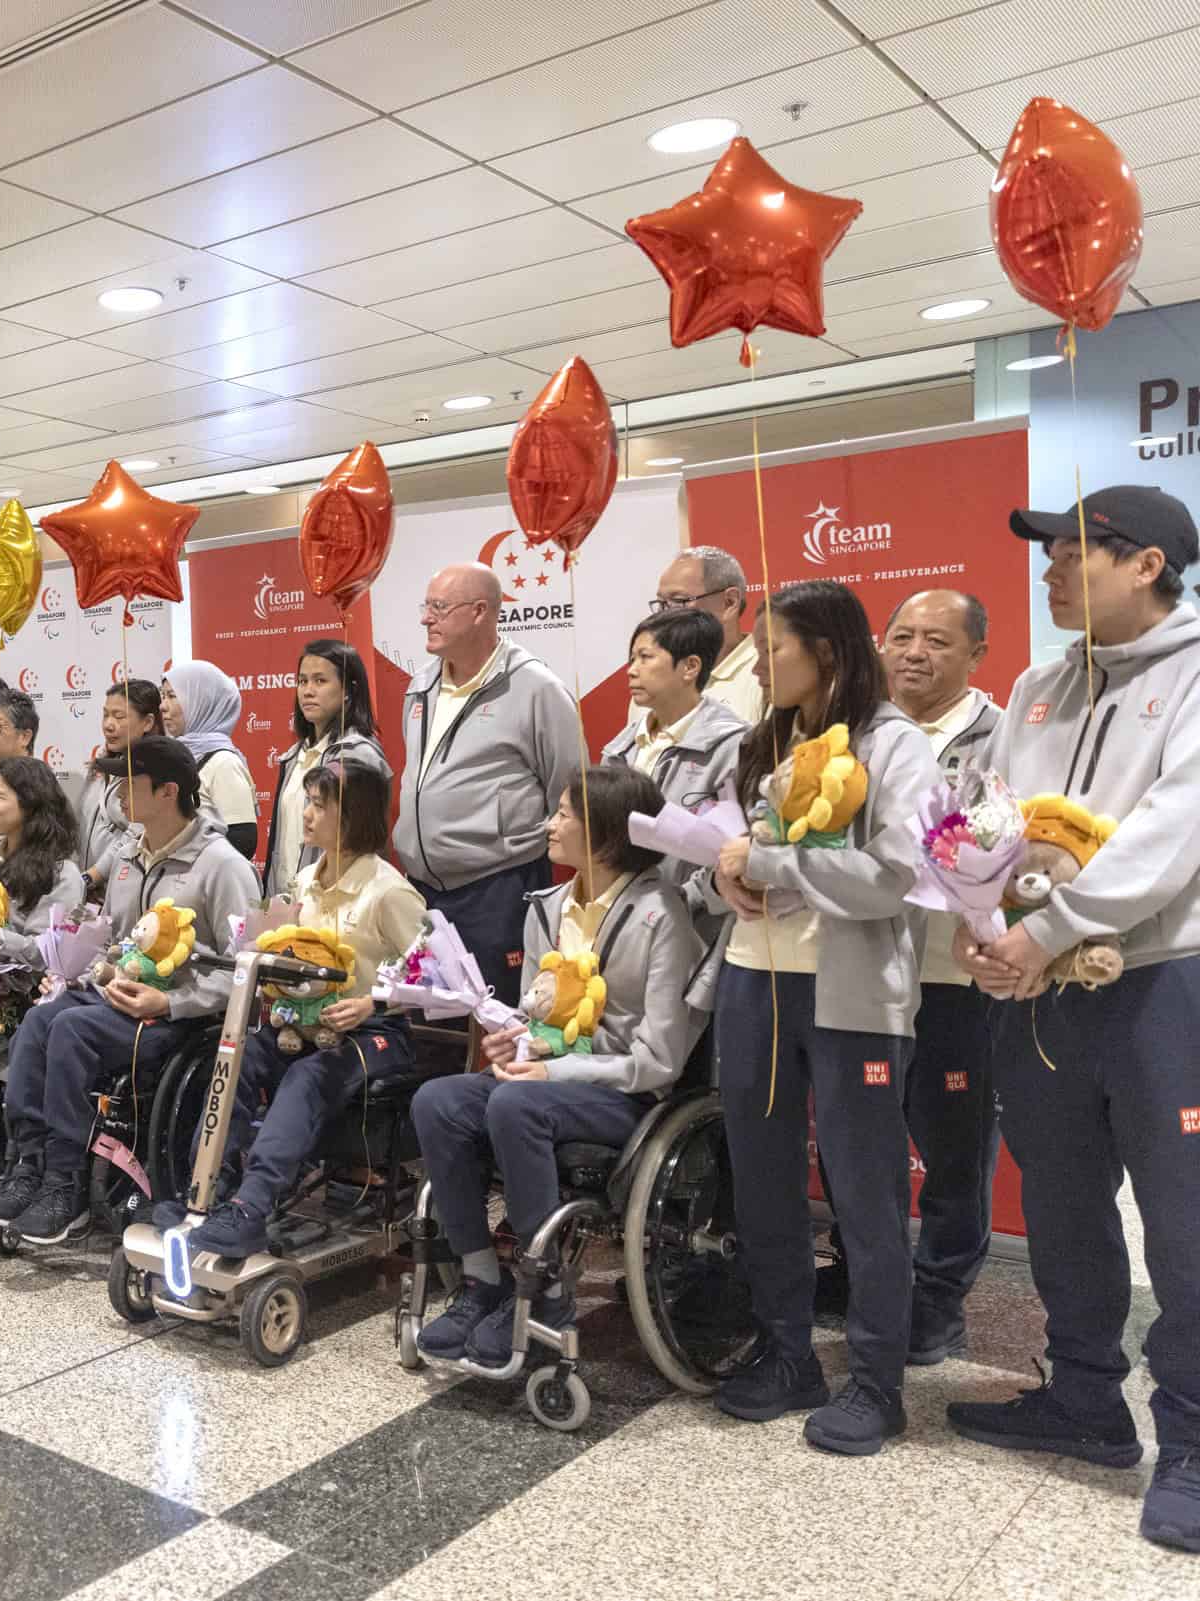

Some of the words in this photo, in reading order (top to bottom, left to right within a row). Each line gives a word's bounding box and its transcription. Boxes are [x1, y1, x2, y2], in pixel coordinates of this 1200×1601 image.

[828, 522, 892, 545] team
[829, 540, 892, 555] SINGAPORE
[874, 564, 965, 580] PERSEVERANCE
[269, 590, 304, 605] team
[497, 604, 574, 623] GAPORE
[866, 1064, 885, 1073] UNI
[866, 1073, 887, 1083] QLO
[947, 1072, 964, 1081] UNI
[204, 1061, 229, 1147] MOBOT
